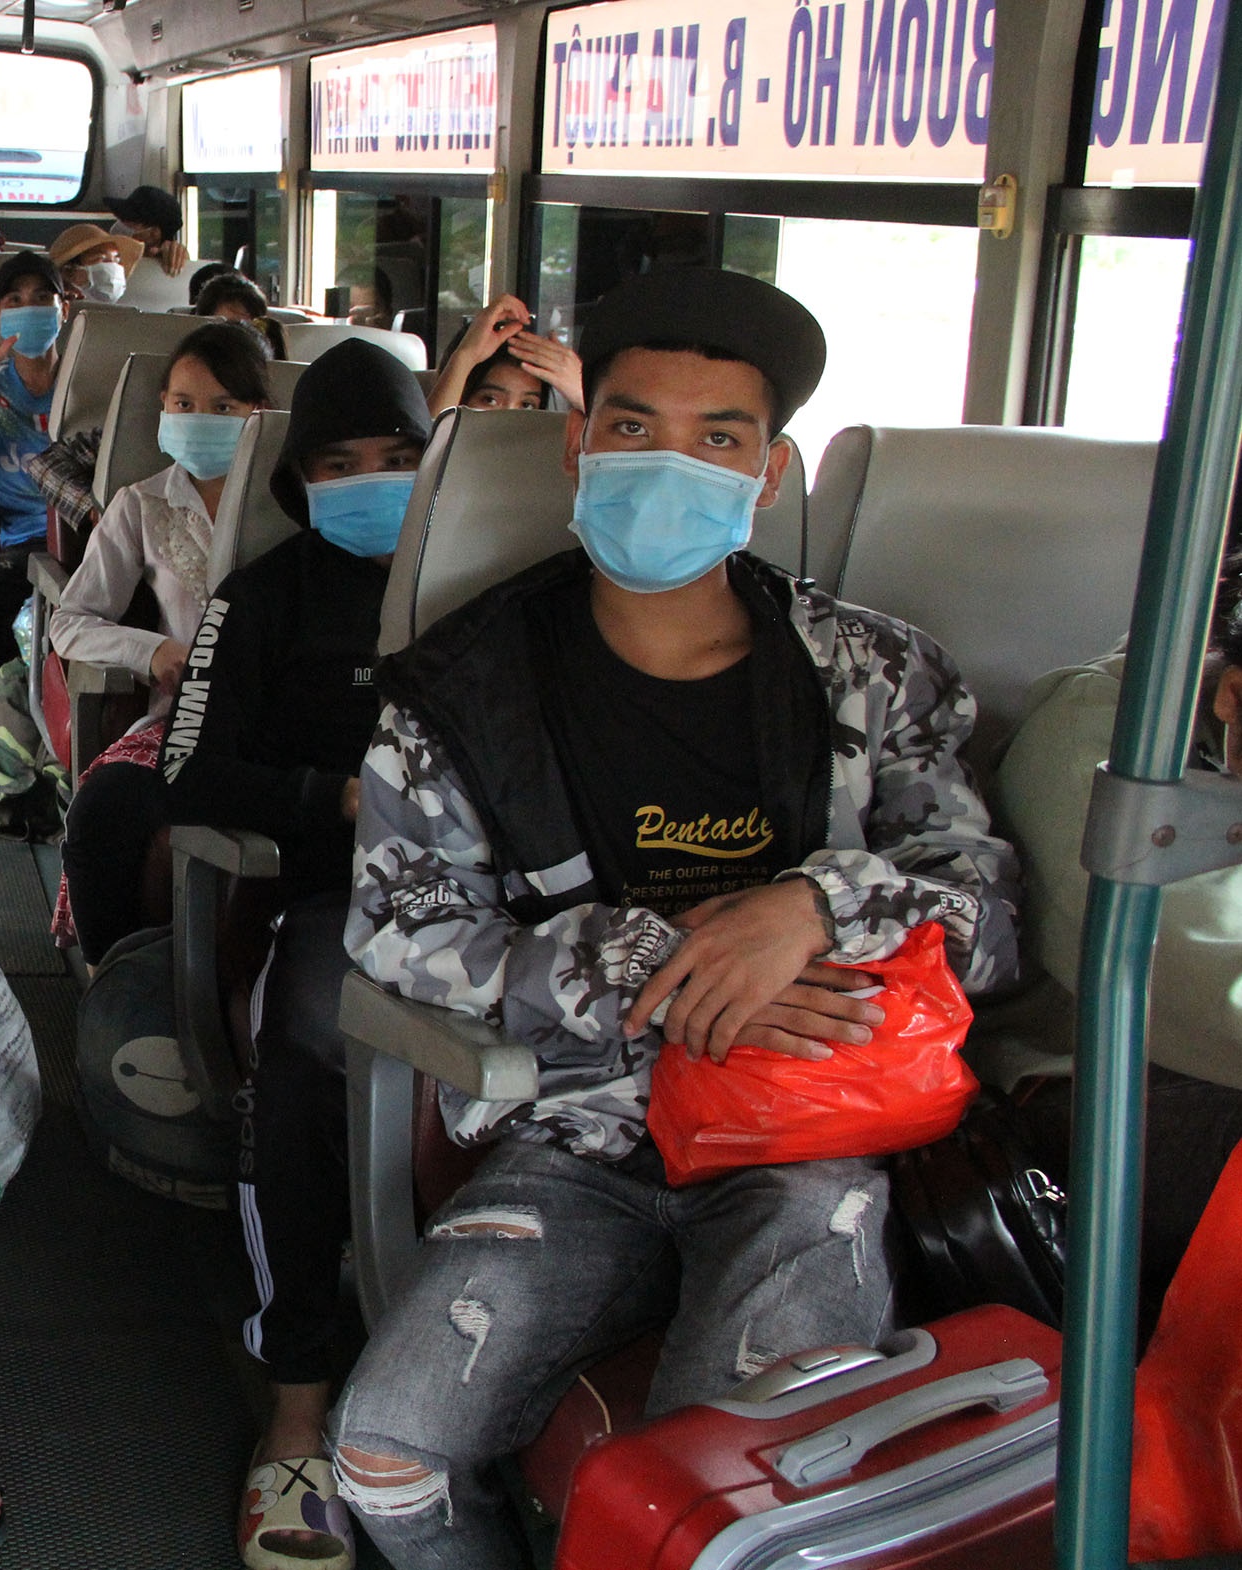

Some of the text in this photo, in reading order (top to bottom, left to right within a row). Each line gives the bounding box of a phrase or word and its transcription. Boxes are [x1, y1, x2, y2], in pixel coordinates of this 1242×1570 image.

[648, 868, 672, 881] THE
[675, 866, 719, 879] OUTER
[629, 881, 720, 899] RESENTATION
